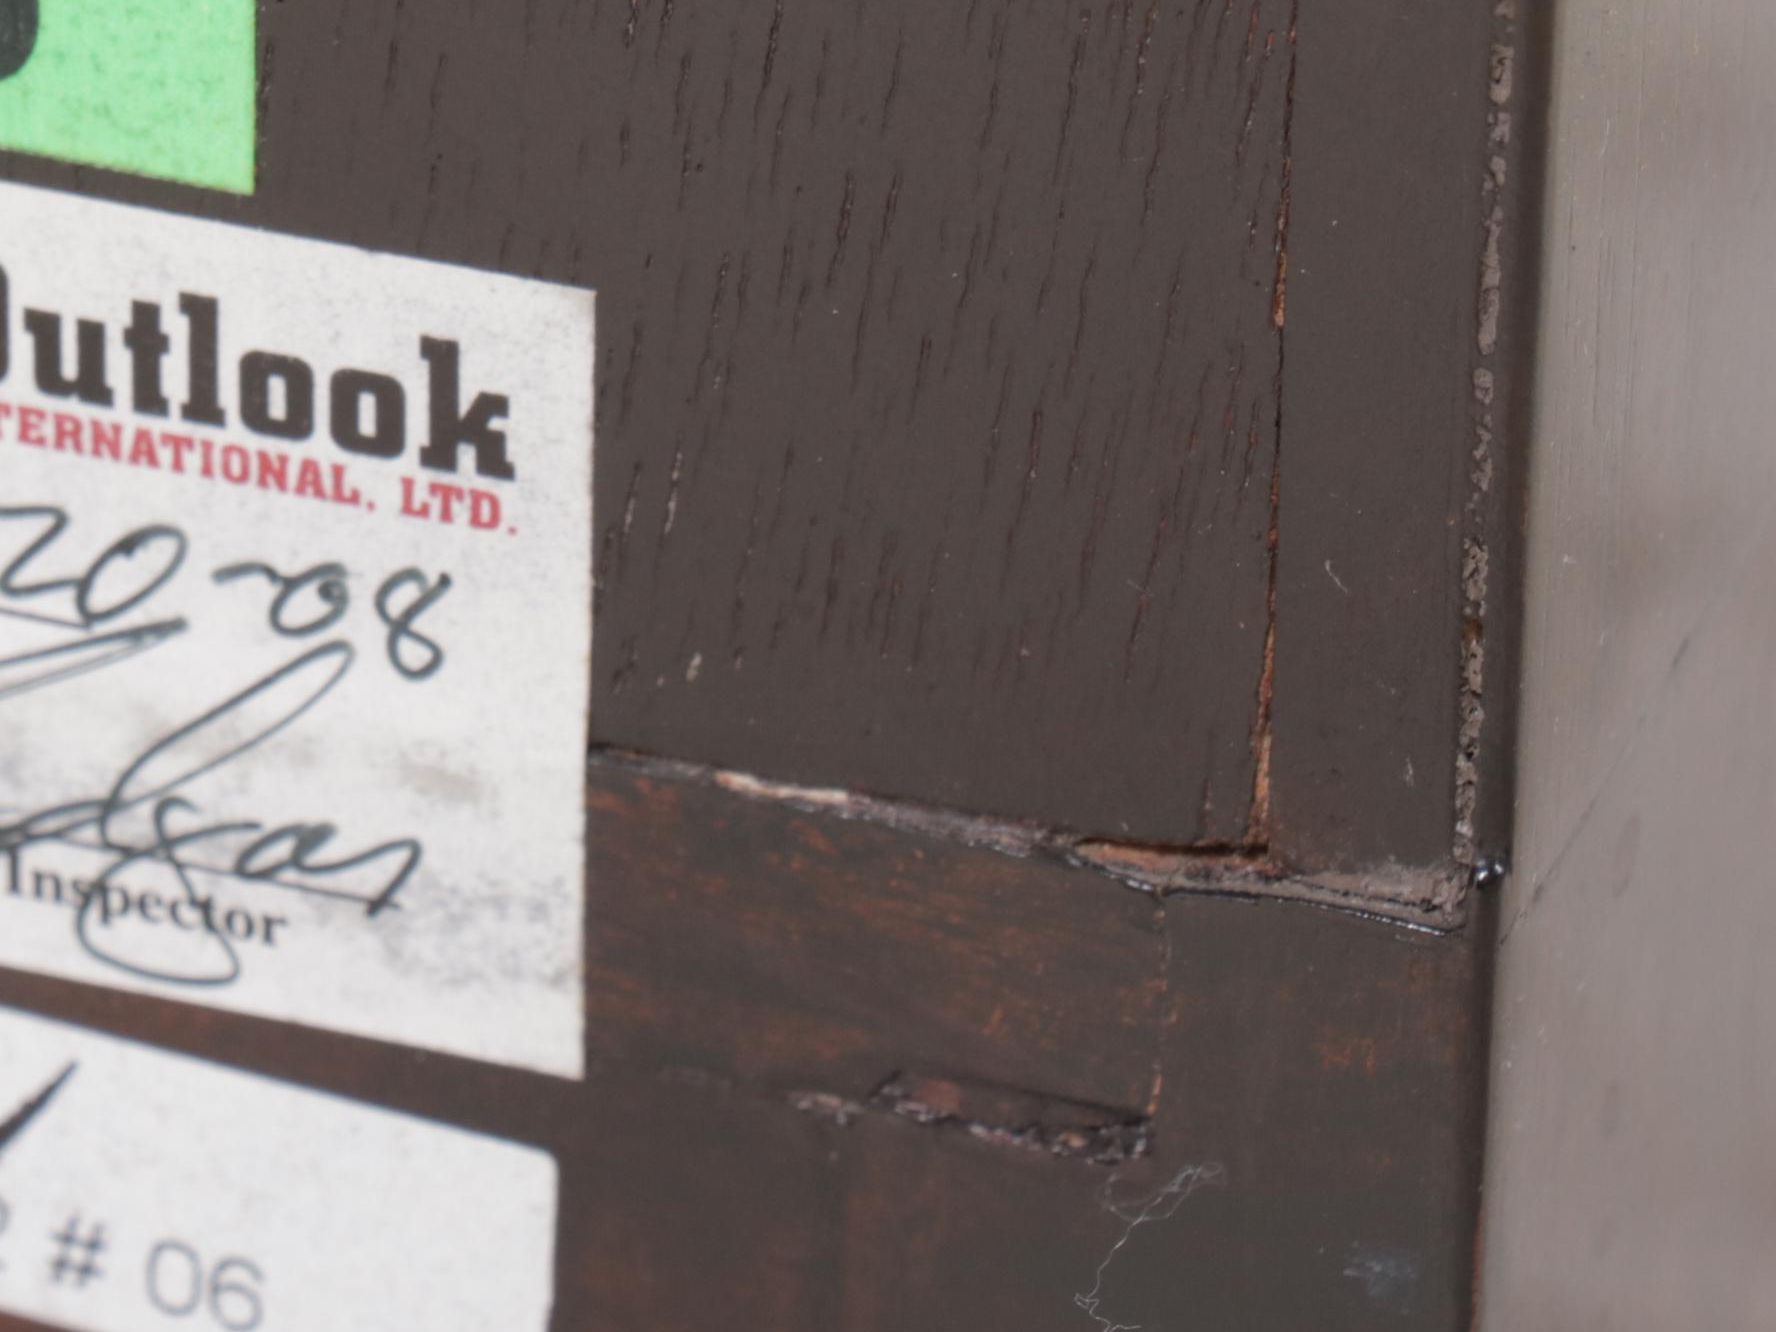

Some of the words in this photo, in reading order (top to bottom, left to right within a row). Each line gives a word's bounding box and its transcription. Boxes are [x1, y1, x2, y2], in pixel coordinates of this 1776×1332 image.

[399, 475, 518, 536] LTD.
[2, 828, 290, 950] Inspector
[49, 1208, 108, 1289] #
[145, 1236, 267, 1332] 06
